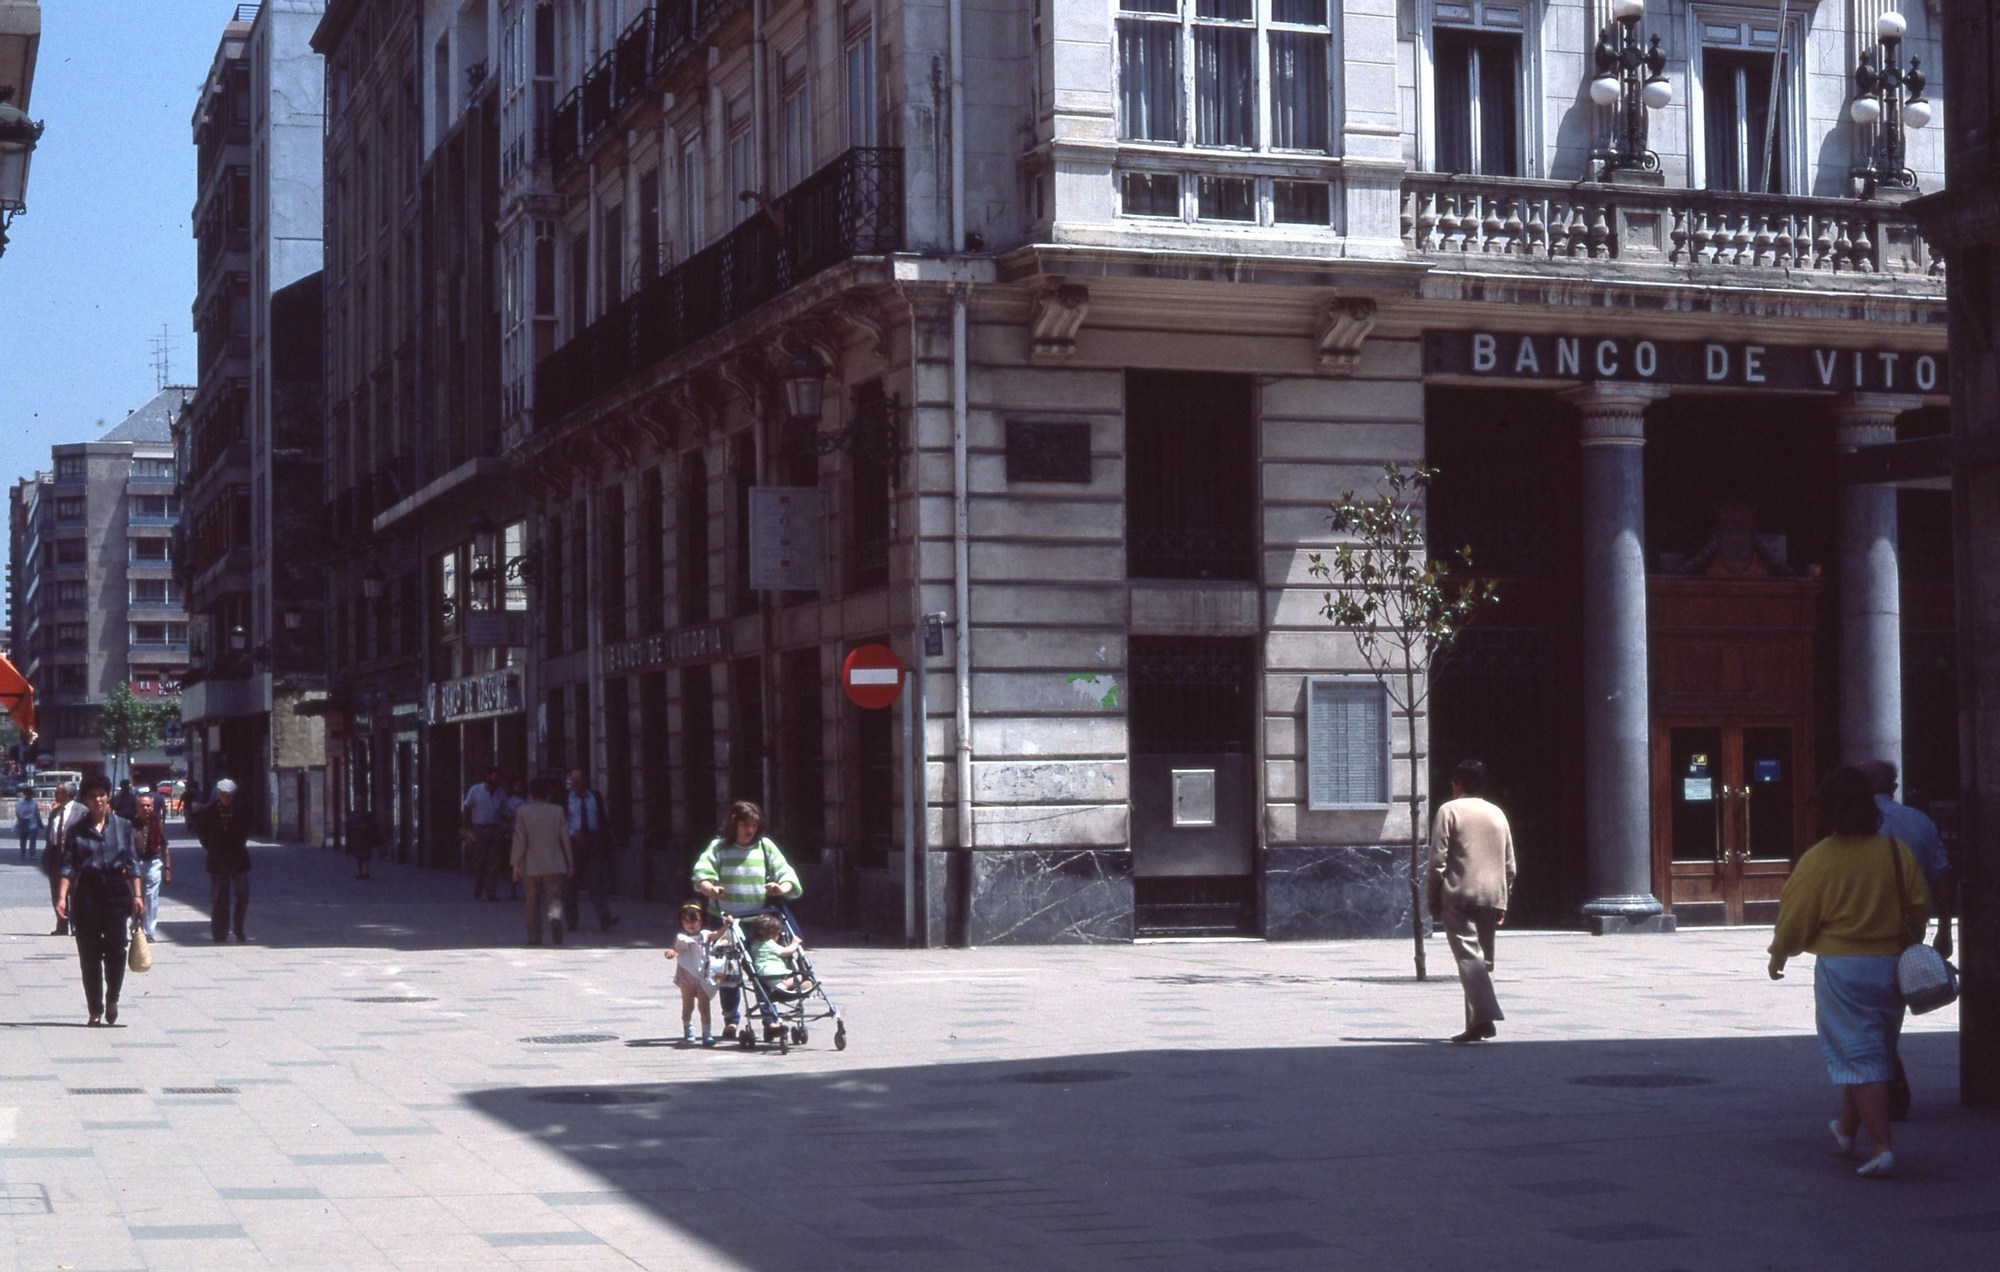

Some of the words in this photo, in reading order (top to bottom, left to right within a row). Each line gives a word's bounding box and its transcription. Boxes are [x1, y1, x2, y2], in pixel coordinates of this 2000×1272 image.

[1472, 333, 1657, 377] BANCO
[1705, 343, 1766, 383] DE
[1814, 348, 1936, 391] VITO
